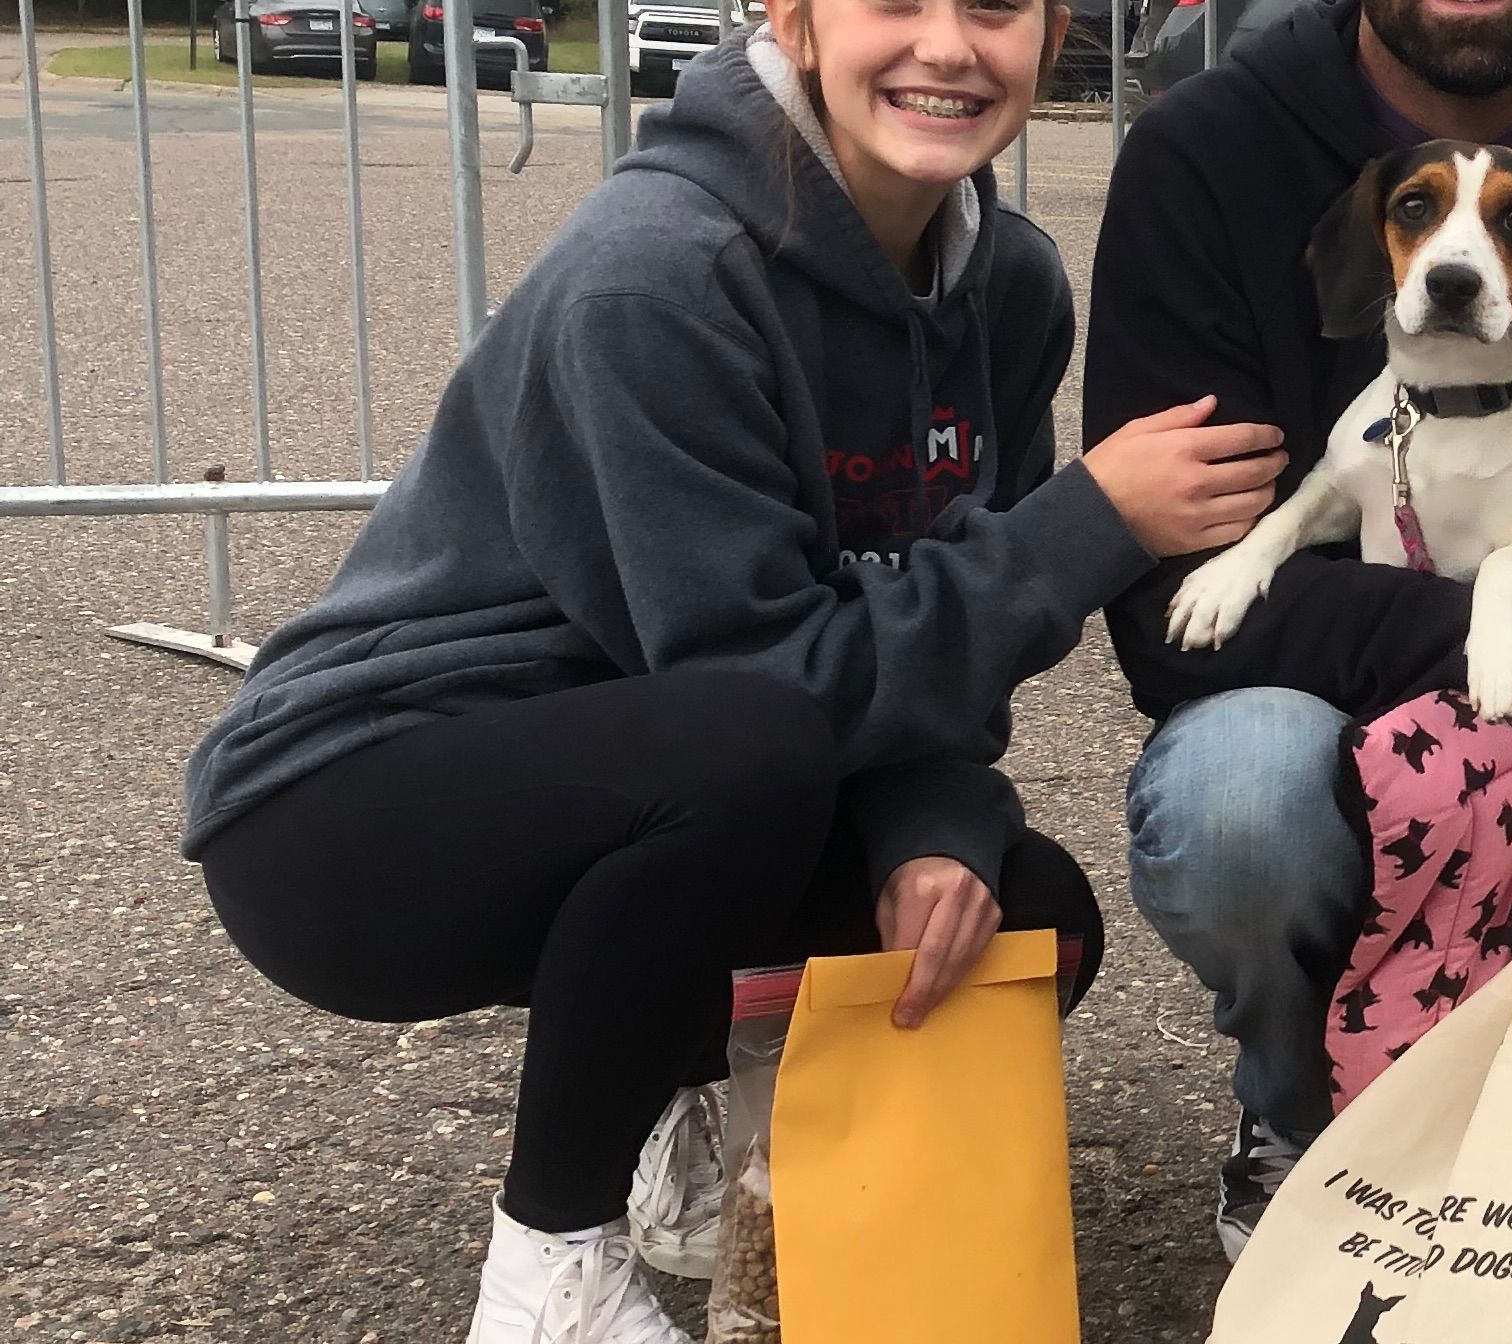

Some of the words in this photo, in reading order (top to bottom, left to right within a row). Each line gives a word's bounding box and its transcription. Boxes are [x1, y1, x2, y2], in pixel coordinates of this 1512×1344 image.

[1324, 1169, 1349, 1188] I
[1344, 1177, 1408, 1221] WAS
[1338, 1231, 1382, 1258] BE
